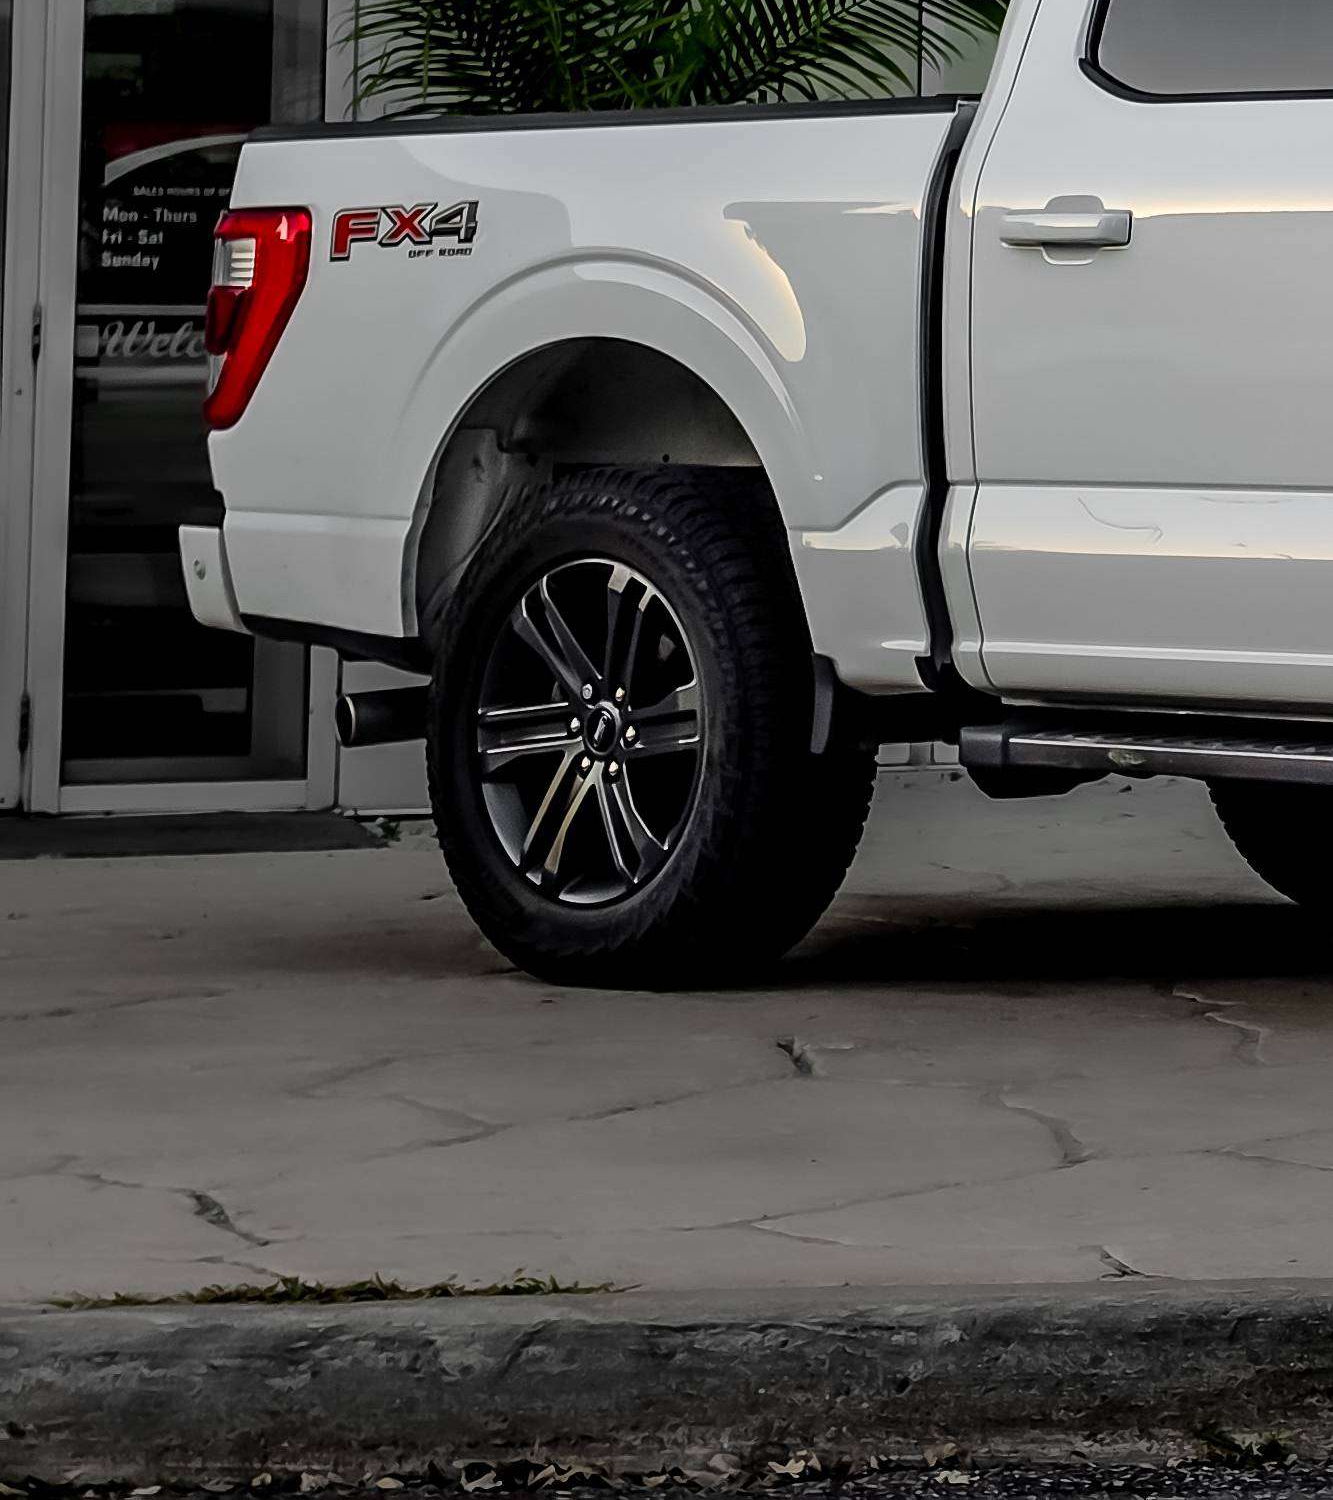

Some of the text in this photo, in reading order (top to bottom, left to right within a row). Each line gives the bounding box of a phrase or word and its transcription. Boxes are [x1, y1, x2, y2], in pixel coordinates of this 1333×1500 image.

[102, 206, 139, 223] Mon
[153, 206, 198, 223] Thurs
[102, 228, 123, 245] Fri
[138, 228, 164, 245] Sat
[329, 200, 480, 263] FX4
[101, 251, 160, 270] Sunday
[408, 247, 473, 259] OFF ROAD
